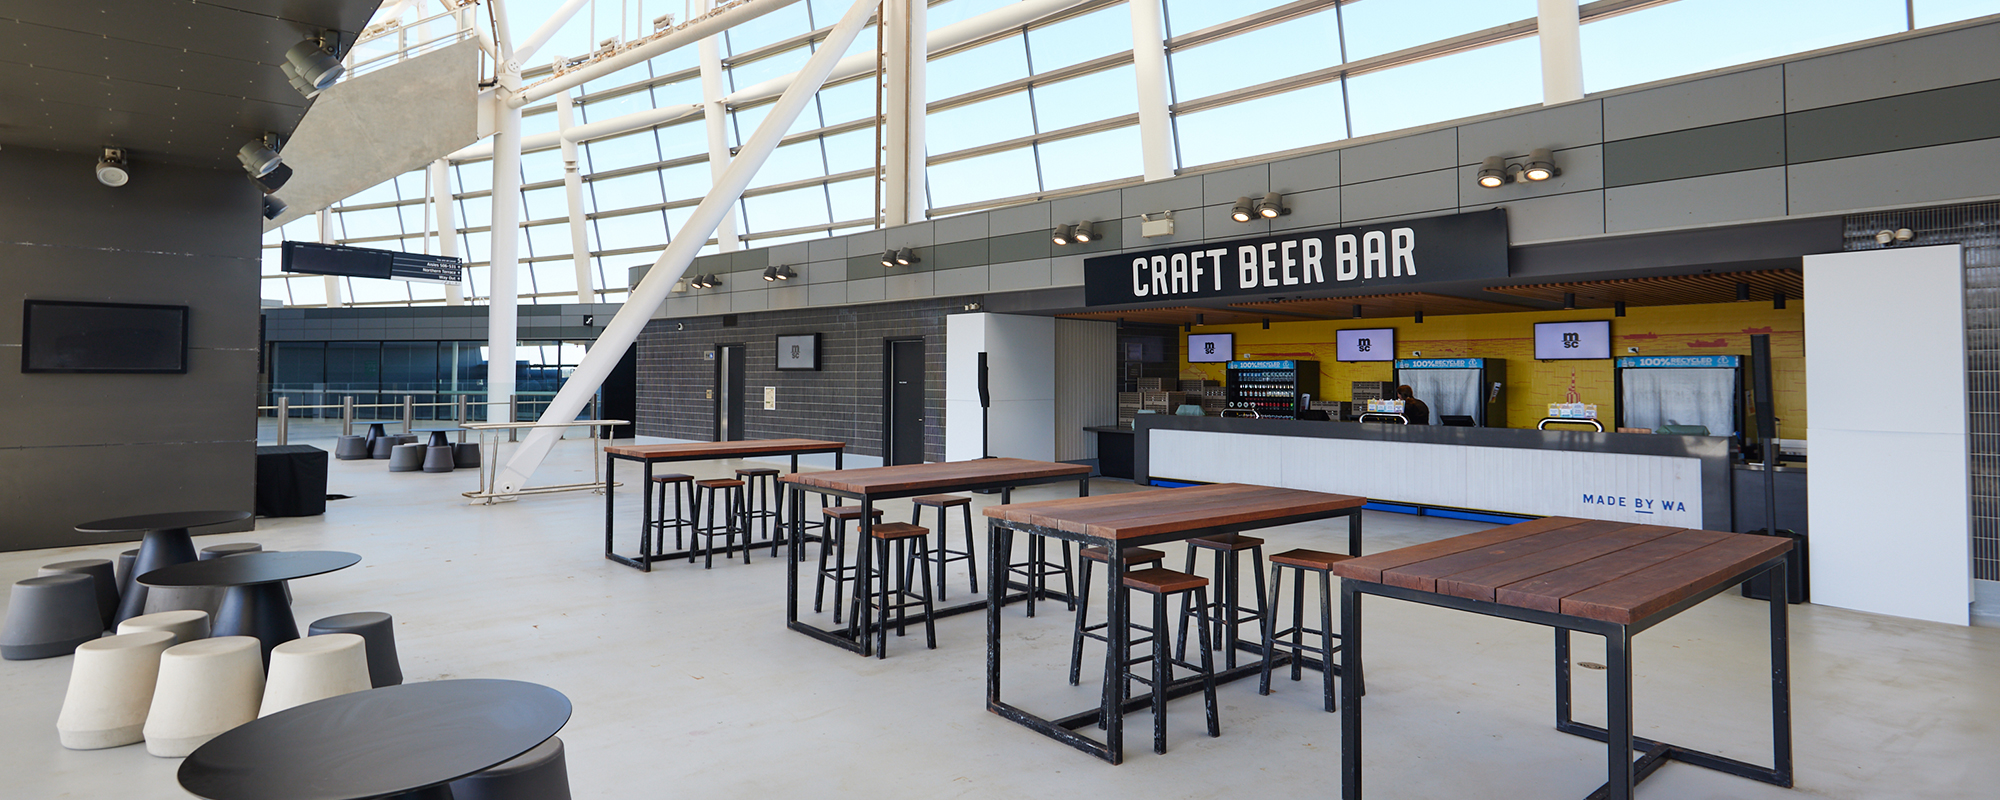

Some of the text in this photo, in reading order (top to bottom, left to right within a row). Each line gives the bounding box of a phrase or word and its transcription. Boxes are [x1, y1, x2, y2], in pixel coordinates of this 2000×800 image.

[1132, 227, 1417, 297] CRAFT BEER BAR
[1640, 358, 1670, 366] 100%
[1583, 493, 1686, 512] MADE BY WA
